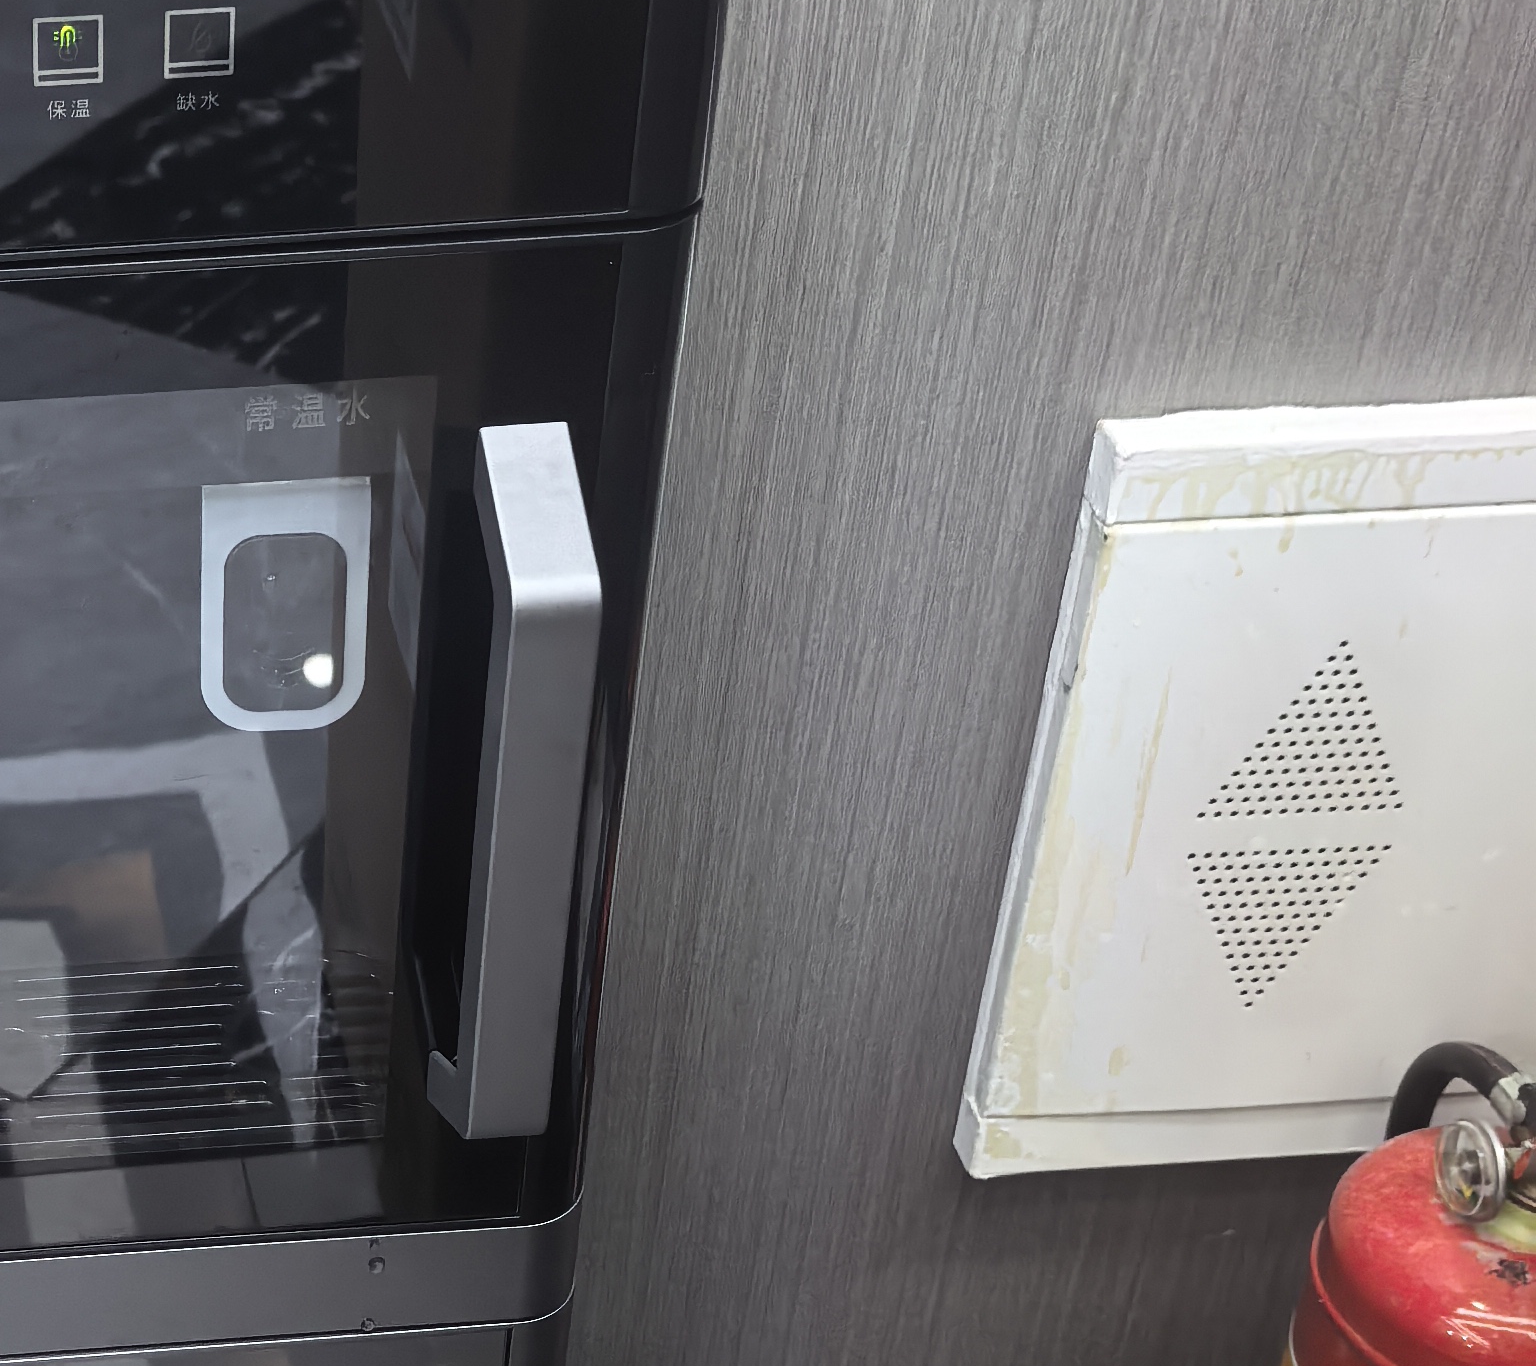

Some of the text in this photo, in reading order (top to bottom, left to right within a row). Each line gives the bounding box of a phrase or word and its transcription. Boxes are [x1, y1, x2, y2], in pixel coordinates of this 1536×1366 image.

[47, 99, 91, 121] 保温
[176, 91, 220, 112] 缺水
[244, 393, 371, 433] 常温水
